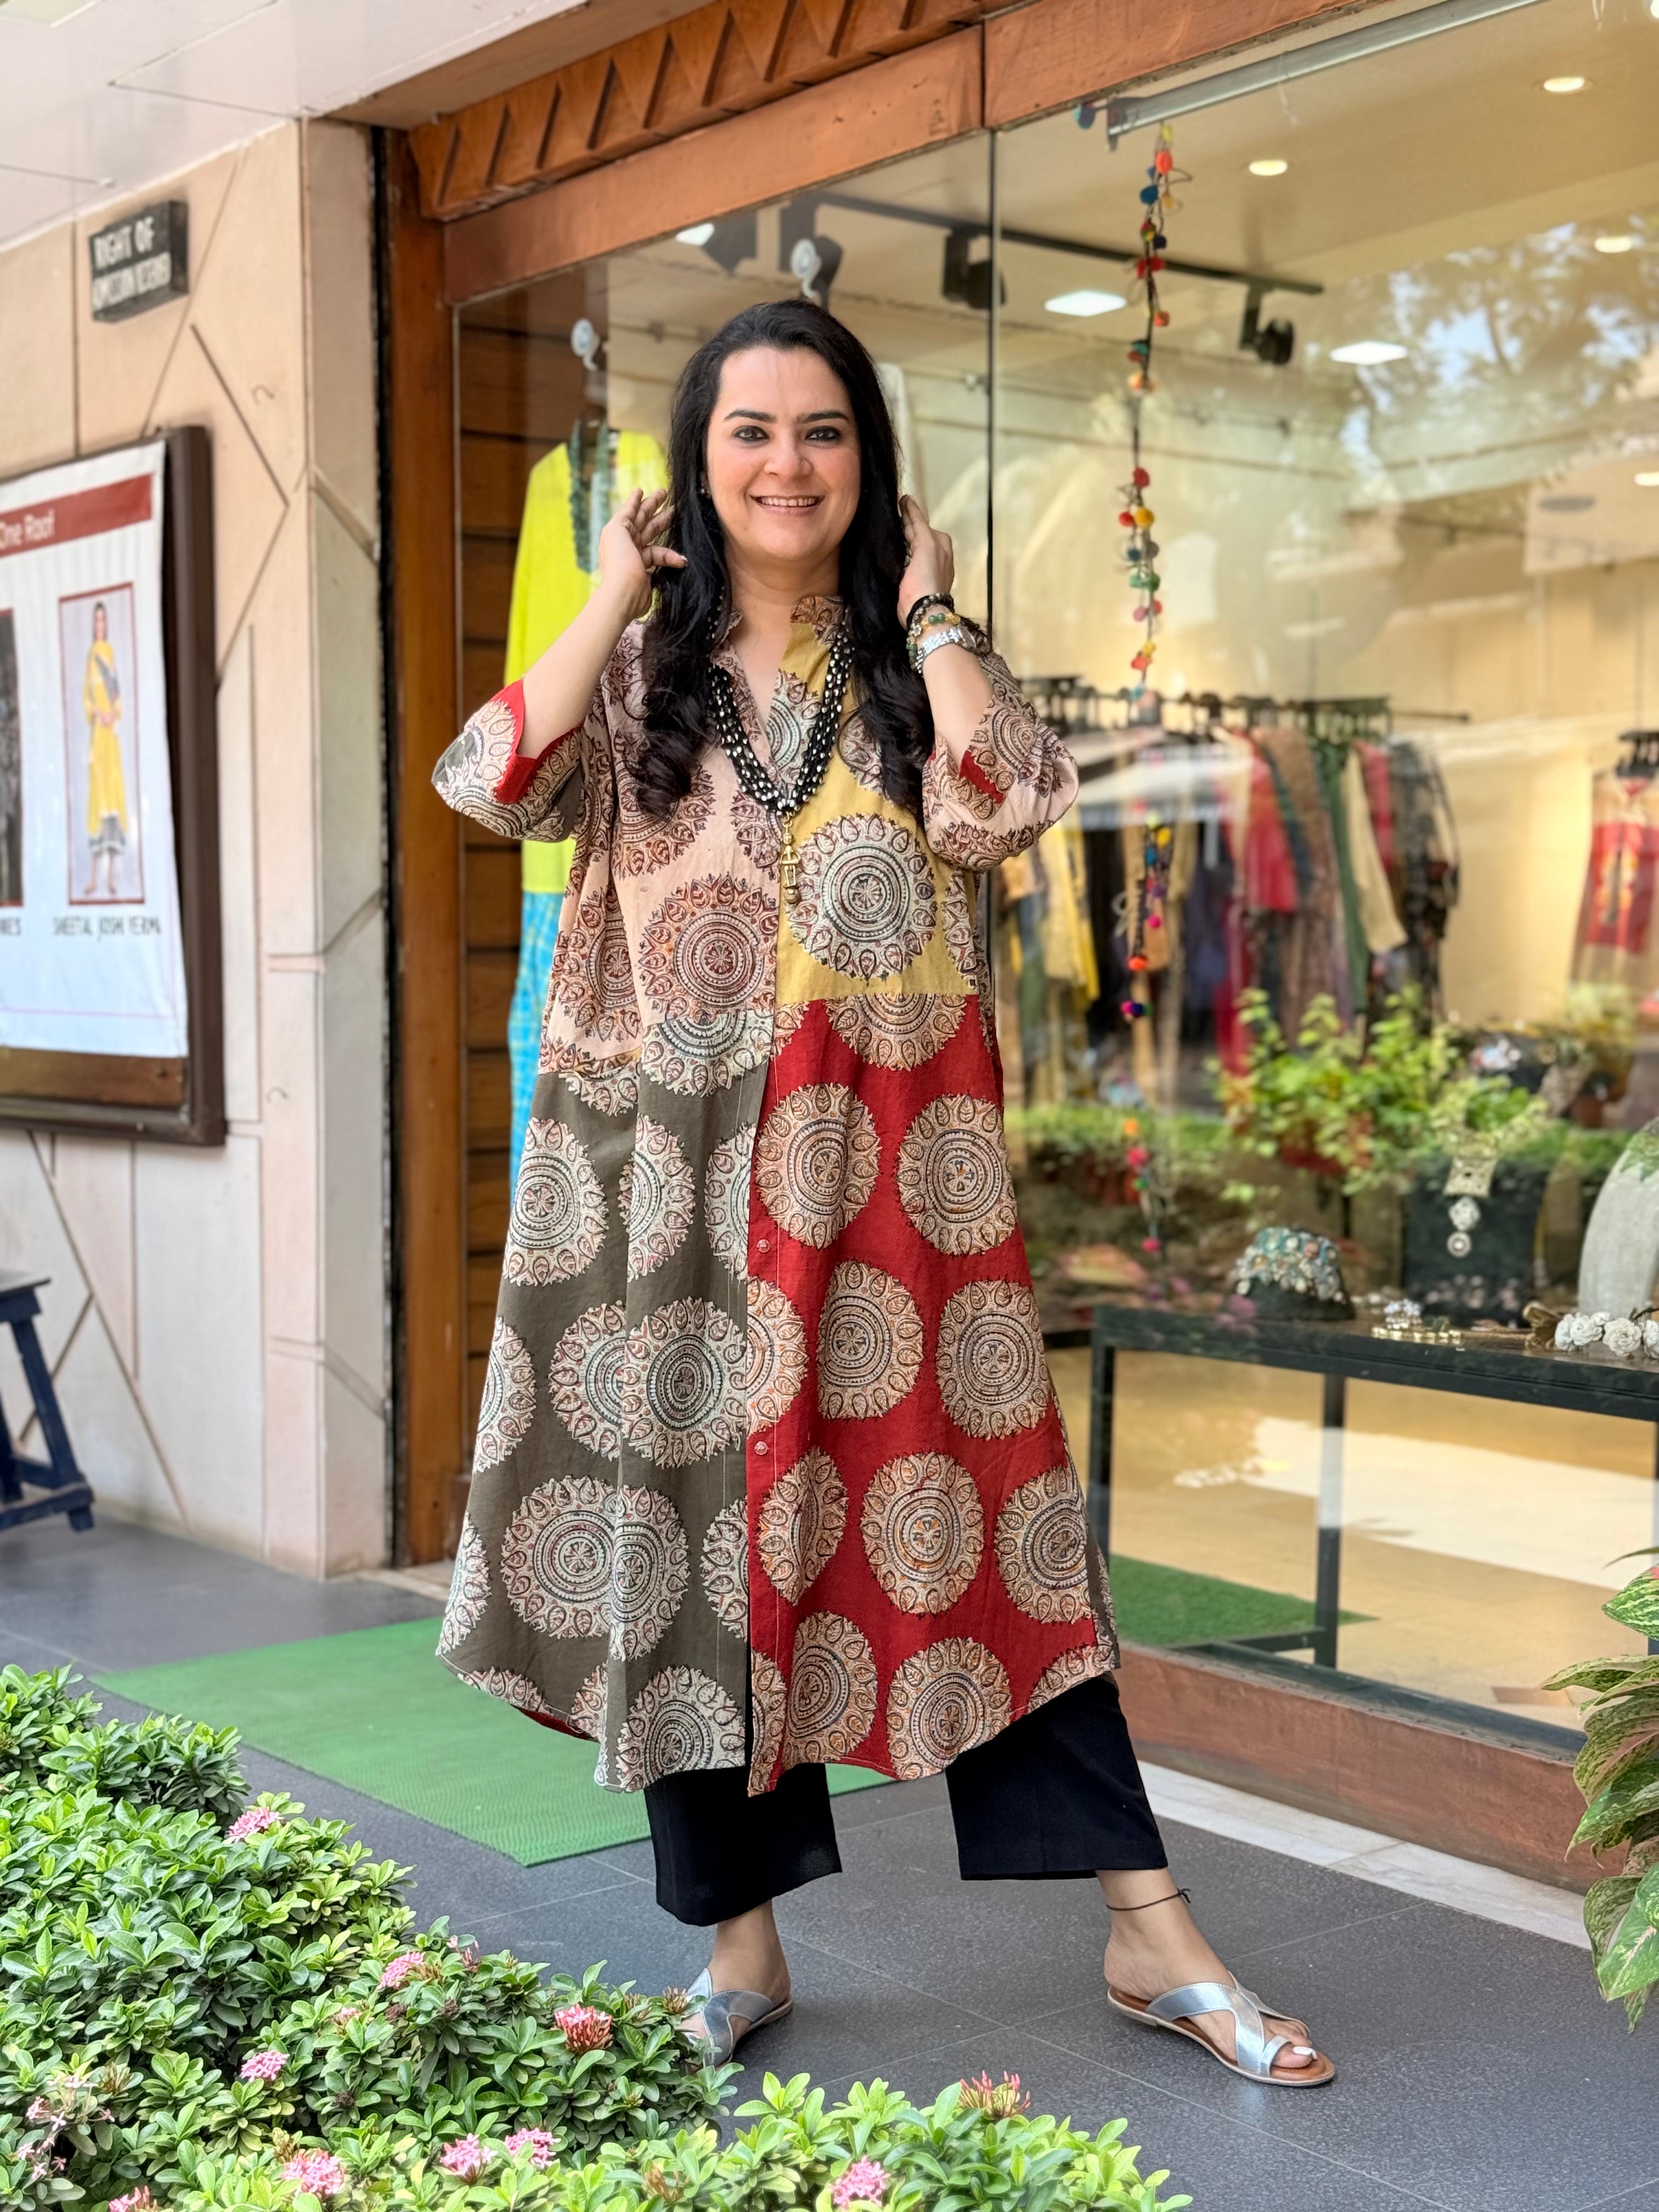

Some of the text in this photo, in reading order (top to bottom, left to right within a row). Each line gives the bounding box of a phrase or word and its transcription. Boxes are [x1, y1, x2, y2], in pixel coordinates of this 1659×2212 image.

[94, 216, 155, 269] RIGHT OF
[24, 509, 55, 542] Roof
